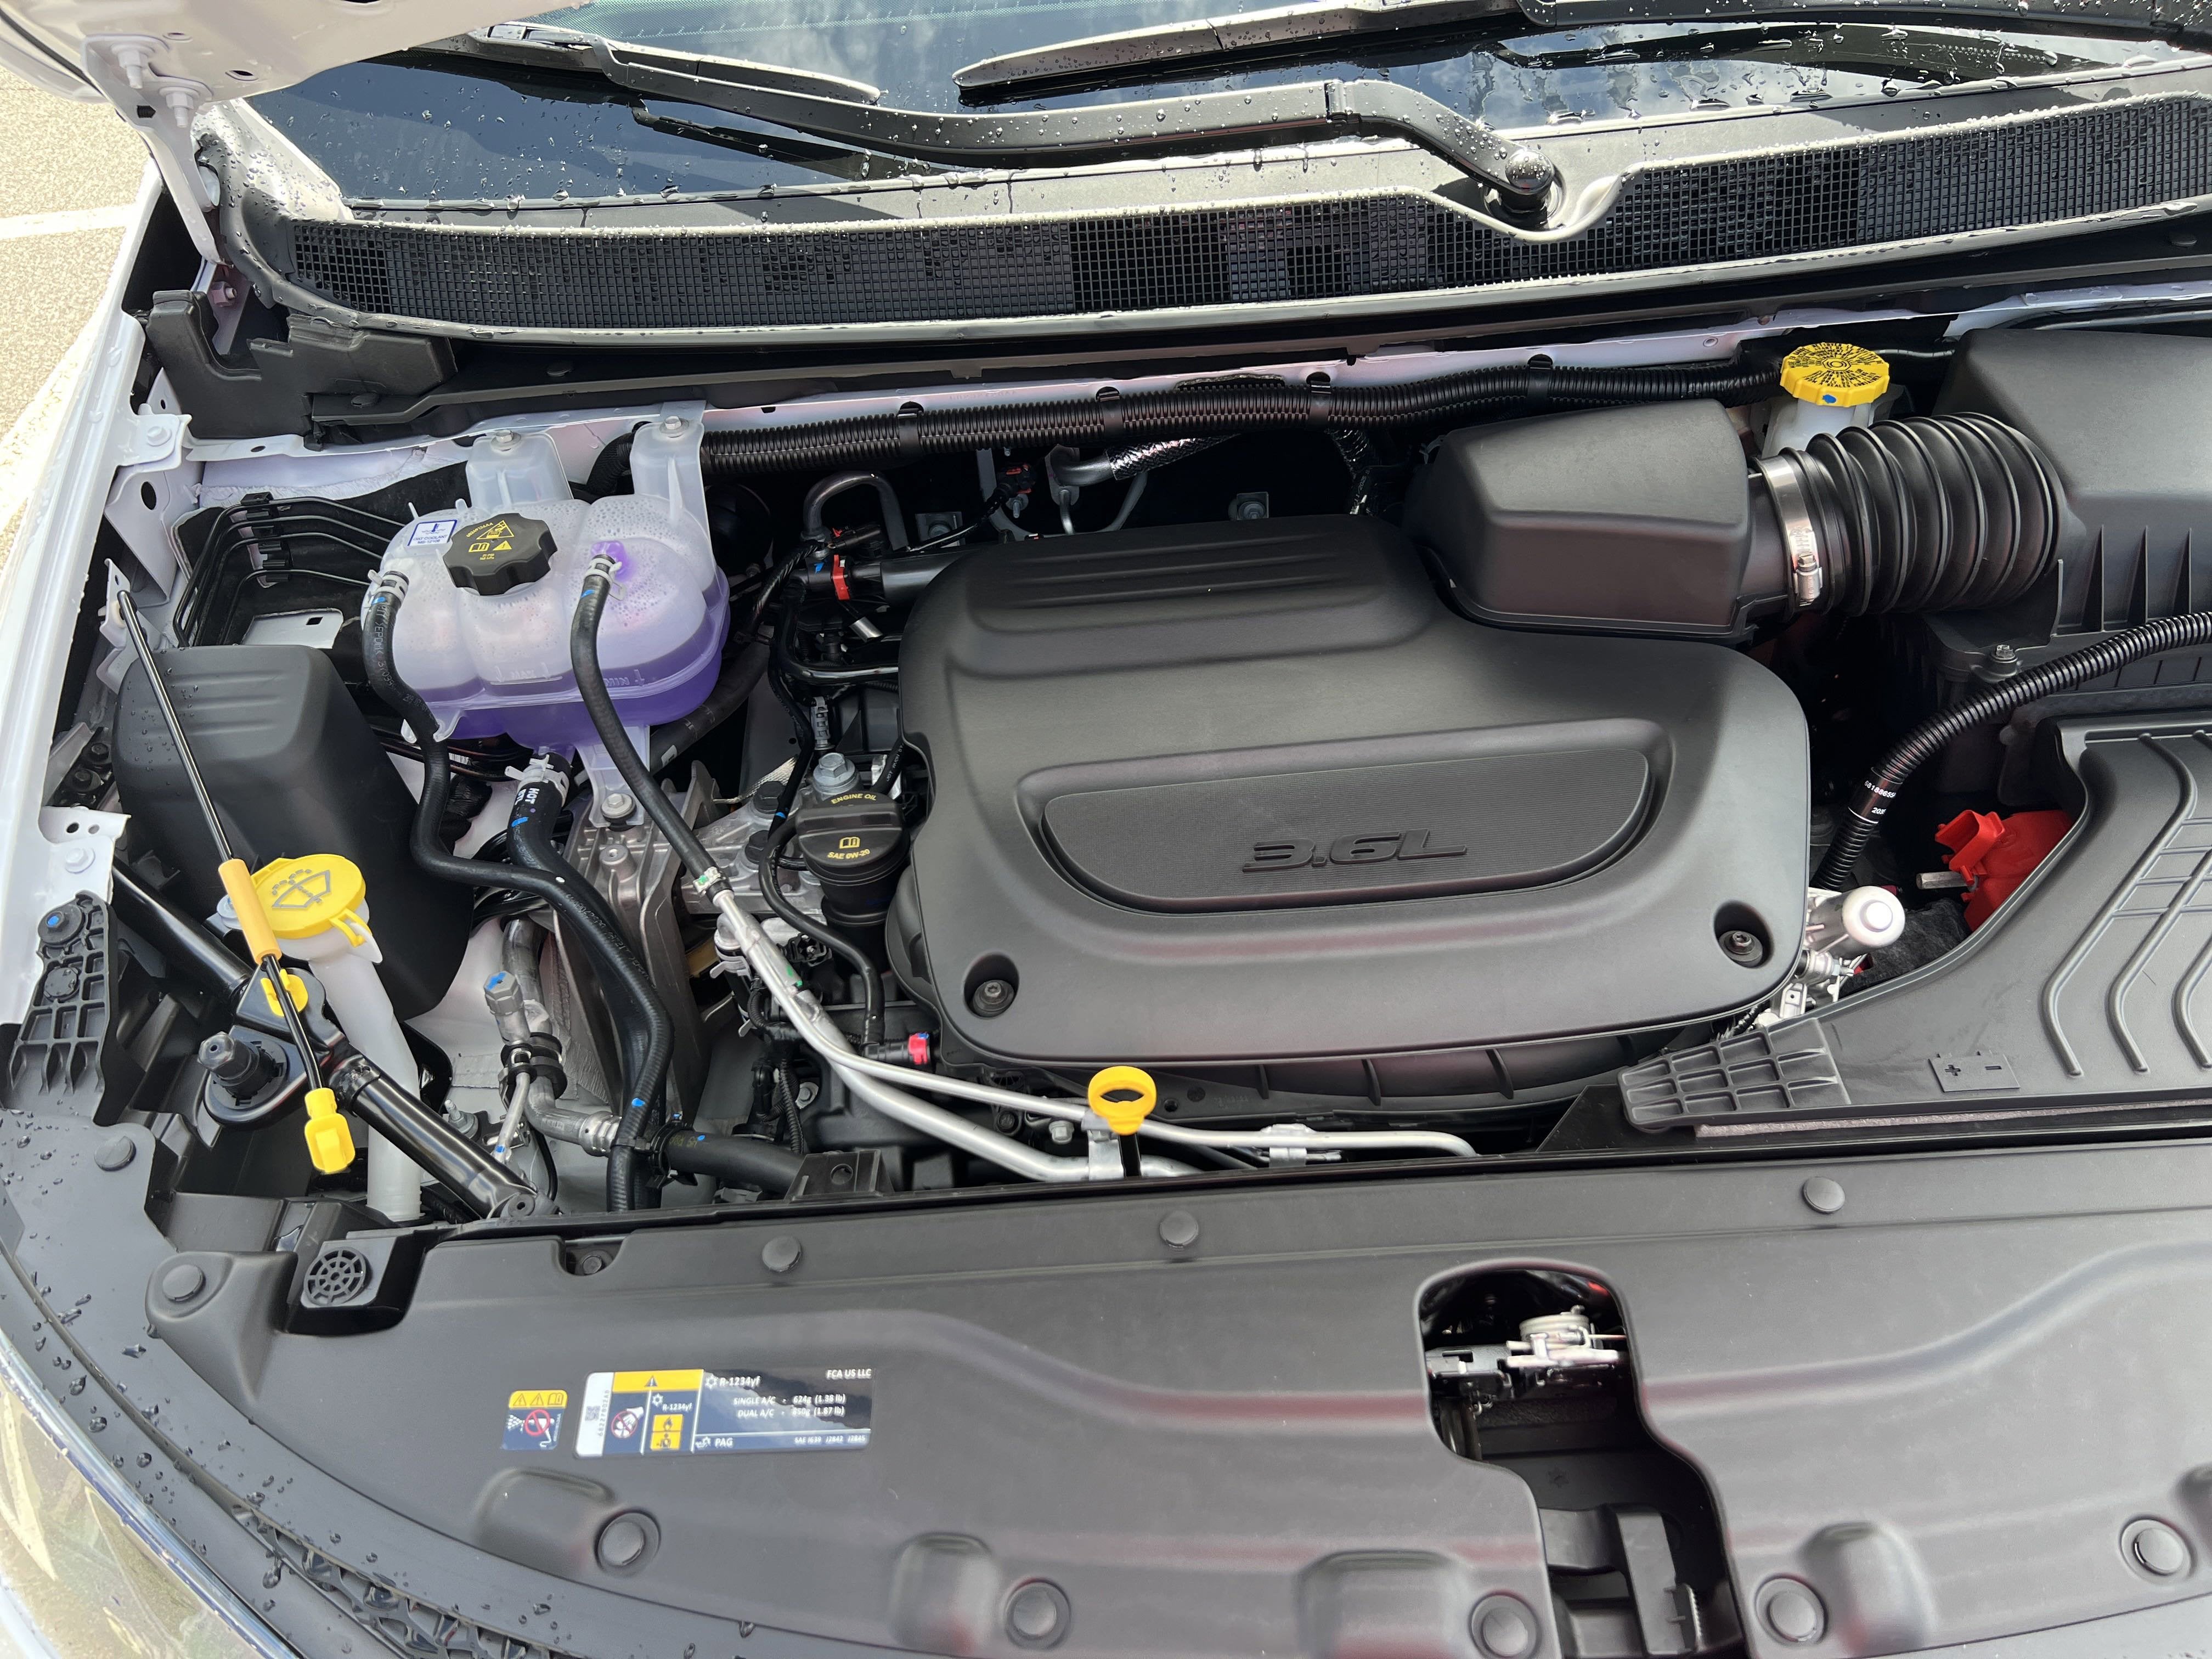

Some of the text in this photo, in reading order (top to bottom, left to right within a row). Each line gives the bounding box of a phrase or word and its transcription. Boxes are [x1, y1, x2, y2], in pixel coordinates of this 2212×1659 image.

[525, 787, 540, 804] HOT
[831, 793, 864, 804] ENGINE
[845, 849, 870, 859] 0W-20
[1242, 828, 1468, 873] 3.6L
[827, 1368, 872, 1379] FCA US LLC
[720, 1376, 760, 1388] R-1234yf
[733, 1397, 759, 1406] SINGLE
[762, 1396, 776, 1406] A/C
[793, 1395, 812, 1405] 624g
[834, 1393, 846, 1404] lb)
[662, 1402, 693, 1412] R-1234yf
[737, 1409, 758, 1418] DUAL
[760, 1408, 774, 1418] A/C
[833, 1406, 845, 1417] lb)
[715, 1438, 733, 1448] PAG
